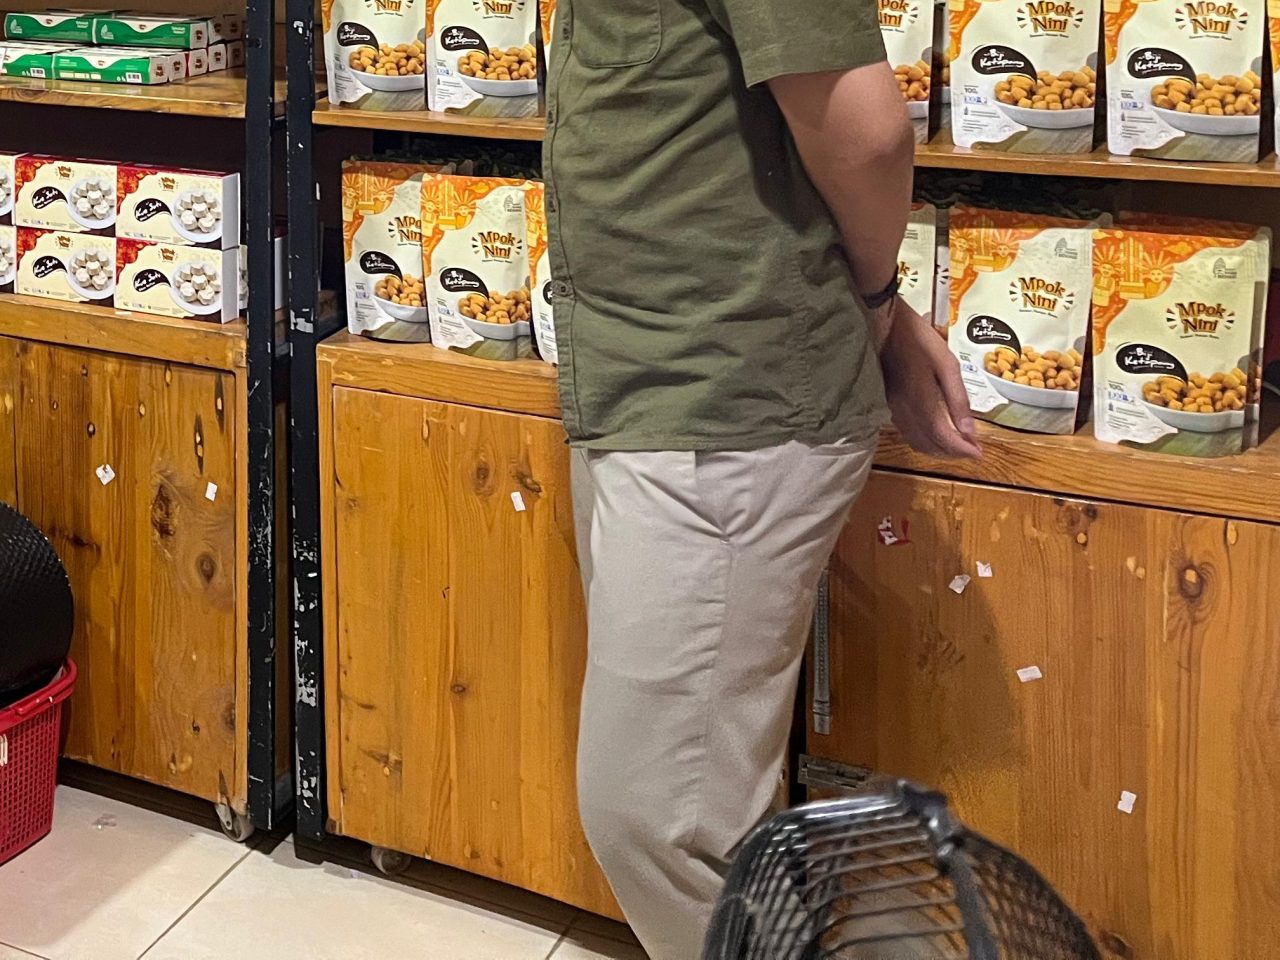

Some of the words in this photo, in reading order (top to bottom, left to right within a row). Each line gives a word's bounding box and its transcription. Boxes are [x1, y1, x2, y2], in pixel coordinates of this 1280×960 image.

[484, 1, 512, 15] Nini
[1026, 0, 1075, 17] Mpok
[1184, 0, 1238, 19] Mpok
[1032, 17, 1068, 33] Nini
[1190, 16, 1231, 35] Nini
[394, 216, 422, 229] Mpo
[399, 229, 422, 242] Nin
[478, 230, 516, 246] Mpok
[484, 243, 511, 259] Nini
[1018, 276, 1066, 296] Mpok
[1022, 292, 1058, 311] Nini
[1175, 302, 1227, 319] Mpok
[1182, 317, 1218, 334] Nini
